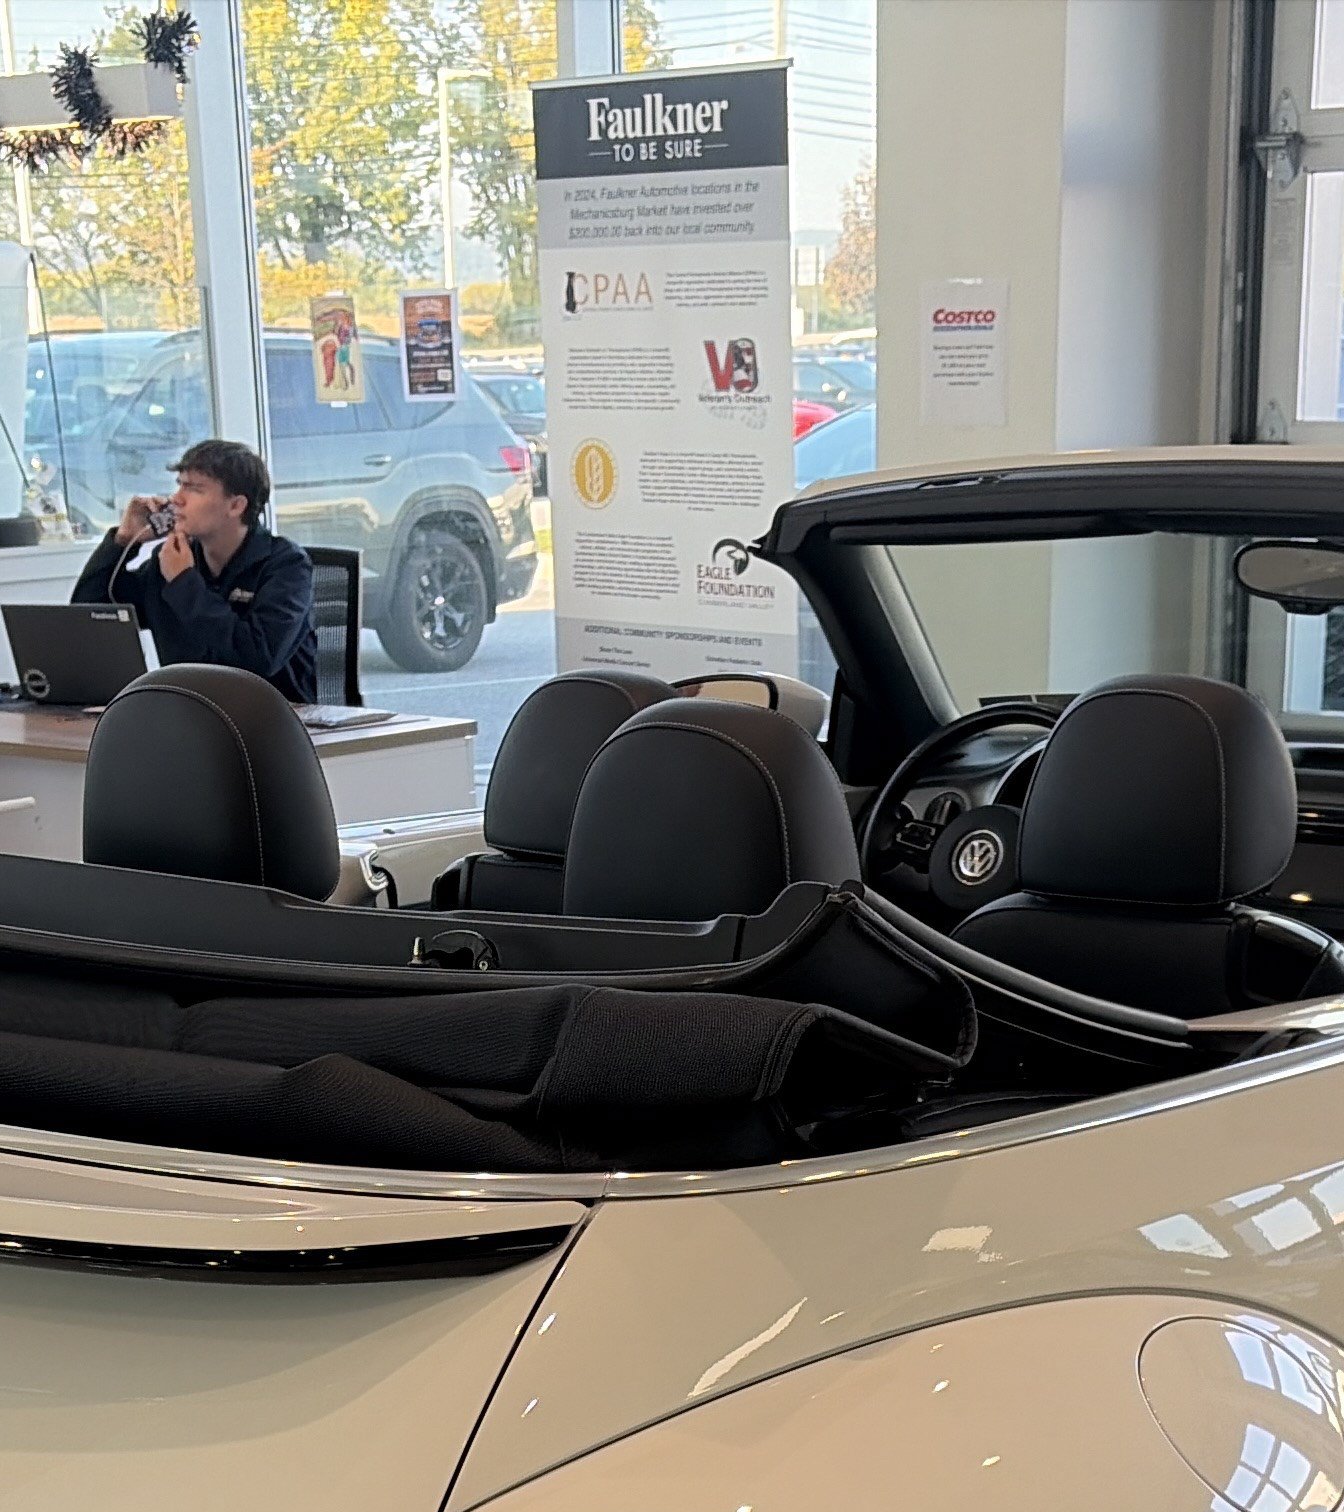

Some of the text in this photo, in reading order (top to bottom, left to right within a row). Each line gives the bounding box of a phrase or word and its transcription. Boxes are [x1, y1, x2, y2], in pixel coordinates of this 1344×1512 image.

[586, 92, 729, 142] Faulkner
[613, 138, 703, 162] TO BE SURE
[696, 563, 732, 581] EAGLE
[696, 579, 776, 599] FOUNDATION
